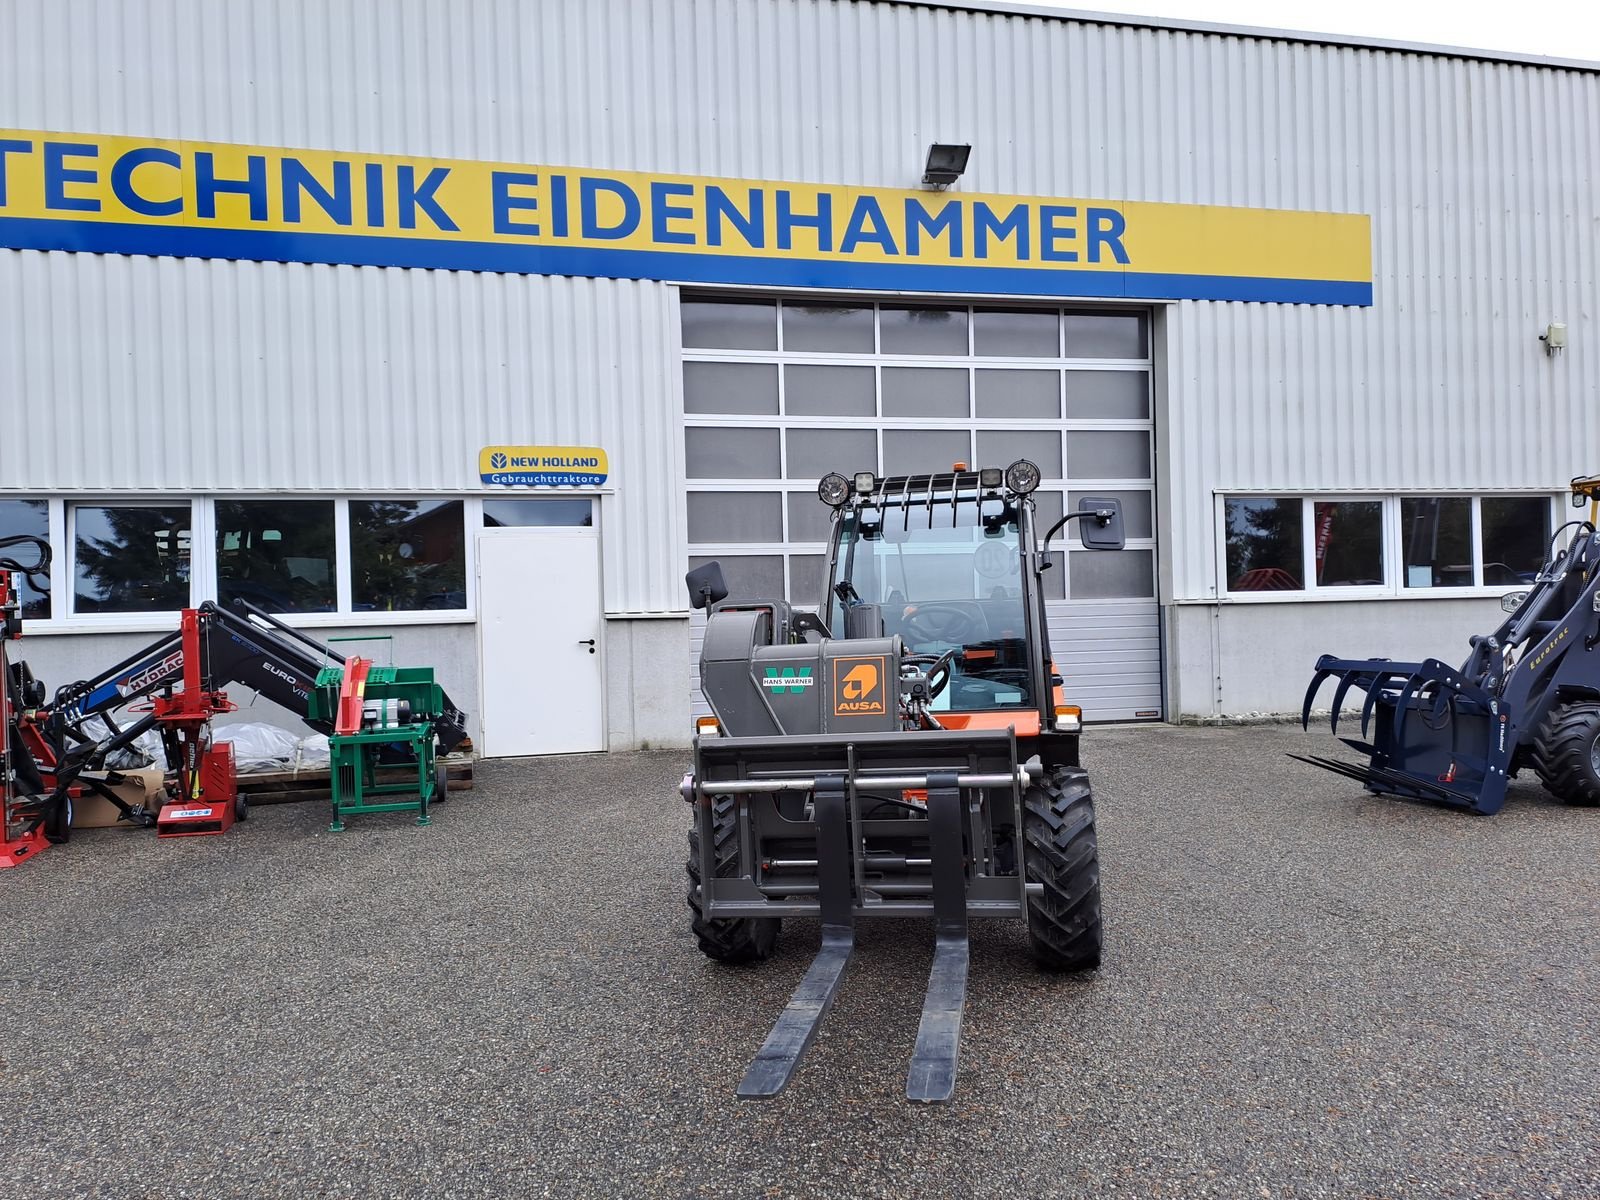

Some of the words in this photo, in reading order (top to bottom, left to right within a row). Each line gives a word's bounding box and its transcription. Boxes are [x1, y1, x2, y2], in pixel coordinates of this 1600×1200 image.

[491, 171, 1130, 265] EIDENHAMMER
[510, 457, 539, 467] NEW
[542, 457, 599, 467] HOLLAND
[491, 474, 600, 483] Gebrauchttraktore
[1530, 627, 1569, 670] Eurotrac
[130, 658, 184, 691] HYDRAC
[763, 678, 783, 686] HANS
[838, 701, 882, 711] AUSA
